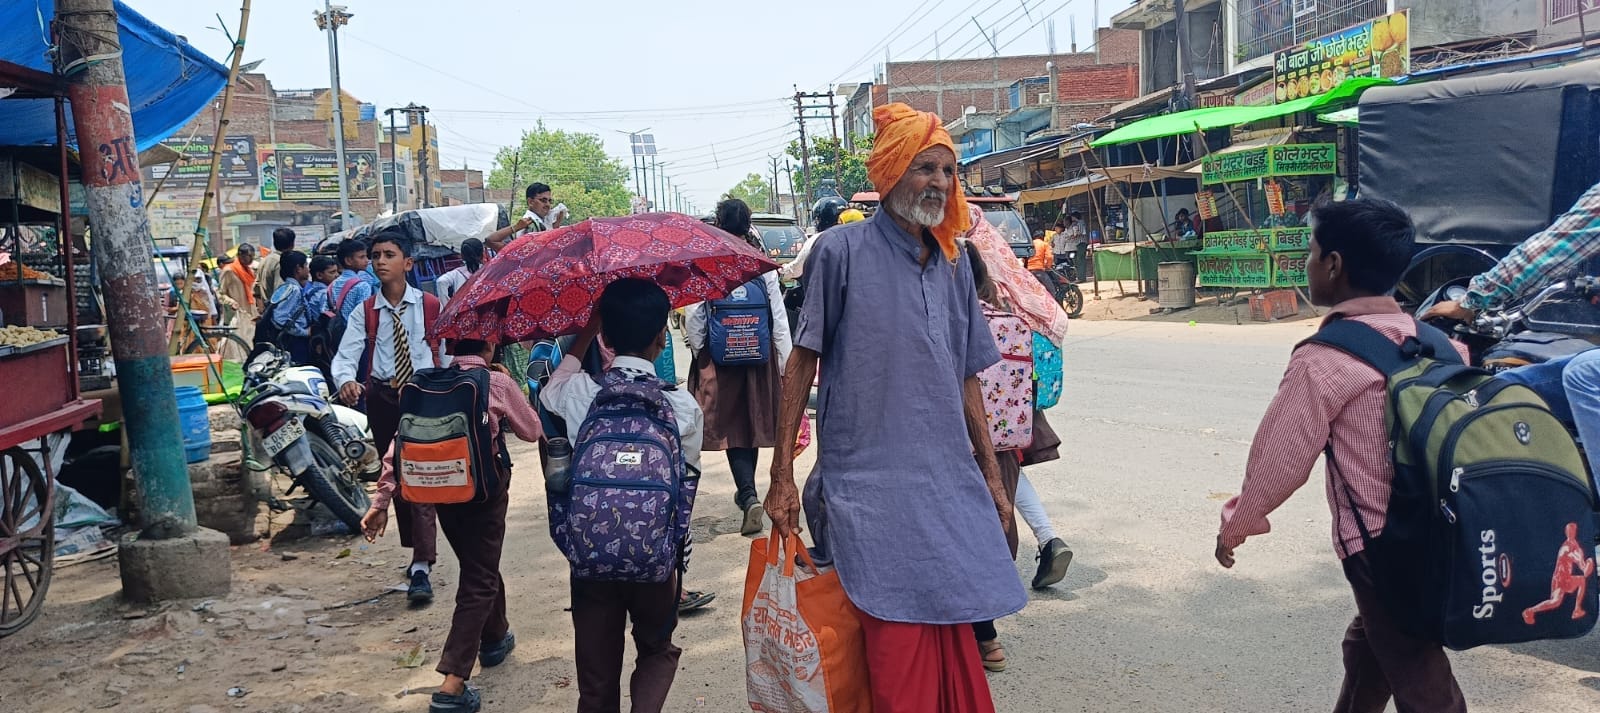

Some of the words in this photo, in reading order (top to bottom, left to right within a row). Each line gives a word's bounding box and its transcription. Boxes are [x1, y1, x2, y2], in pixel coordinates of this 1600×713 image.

[1276, 53, 1287, 73] श्री
[1288, 50, 1308, 69] बाला
[1310, 41, 1323, 62] जी
[1326, 36, 1345, 58] छोले
[1473, 529, 1503, 619] Sports
